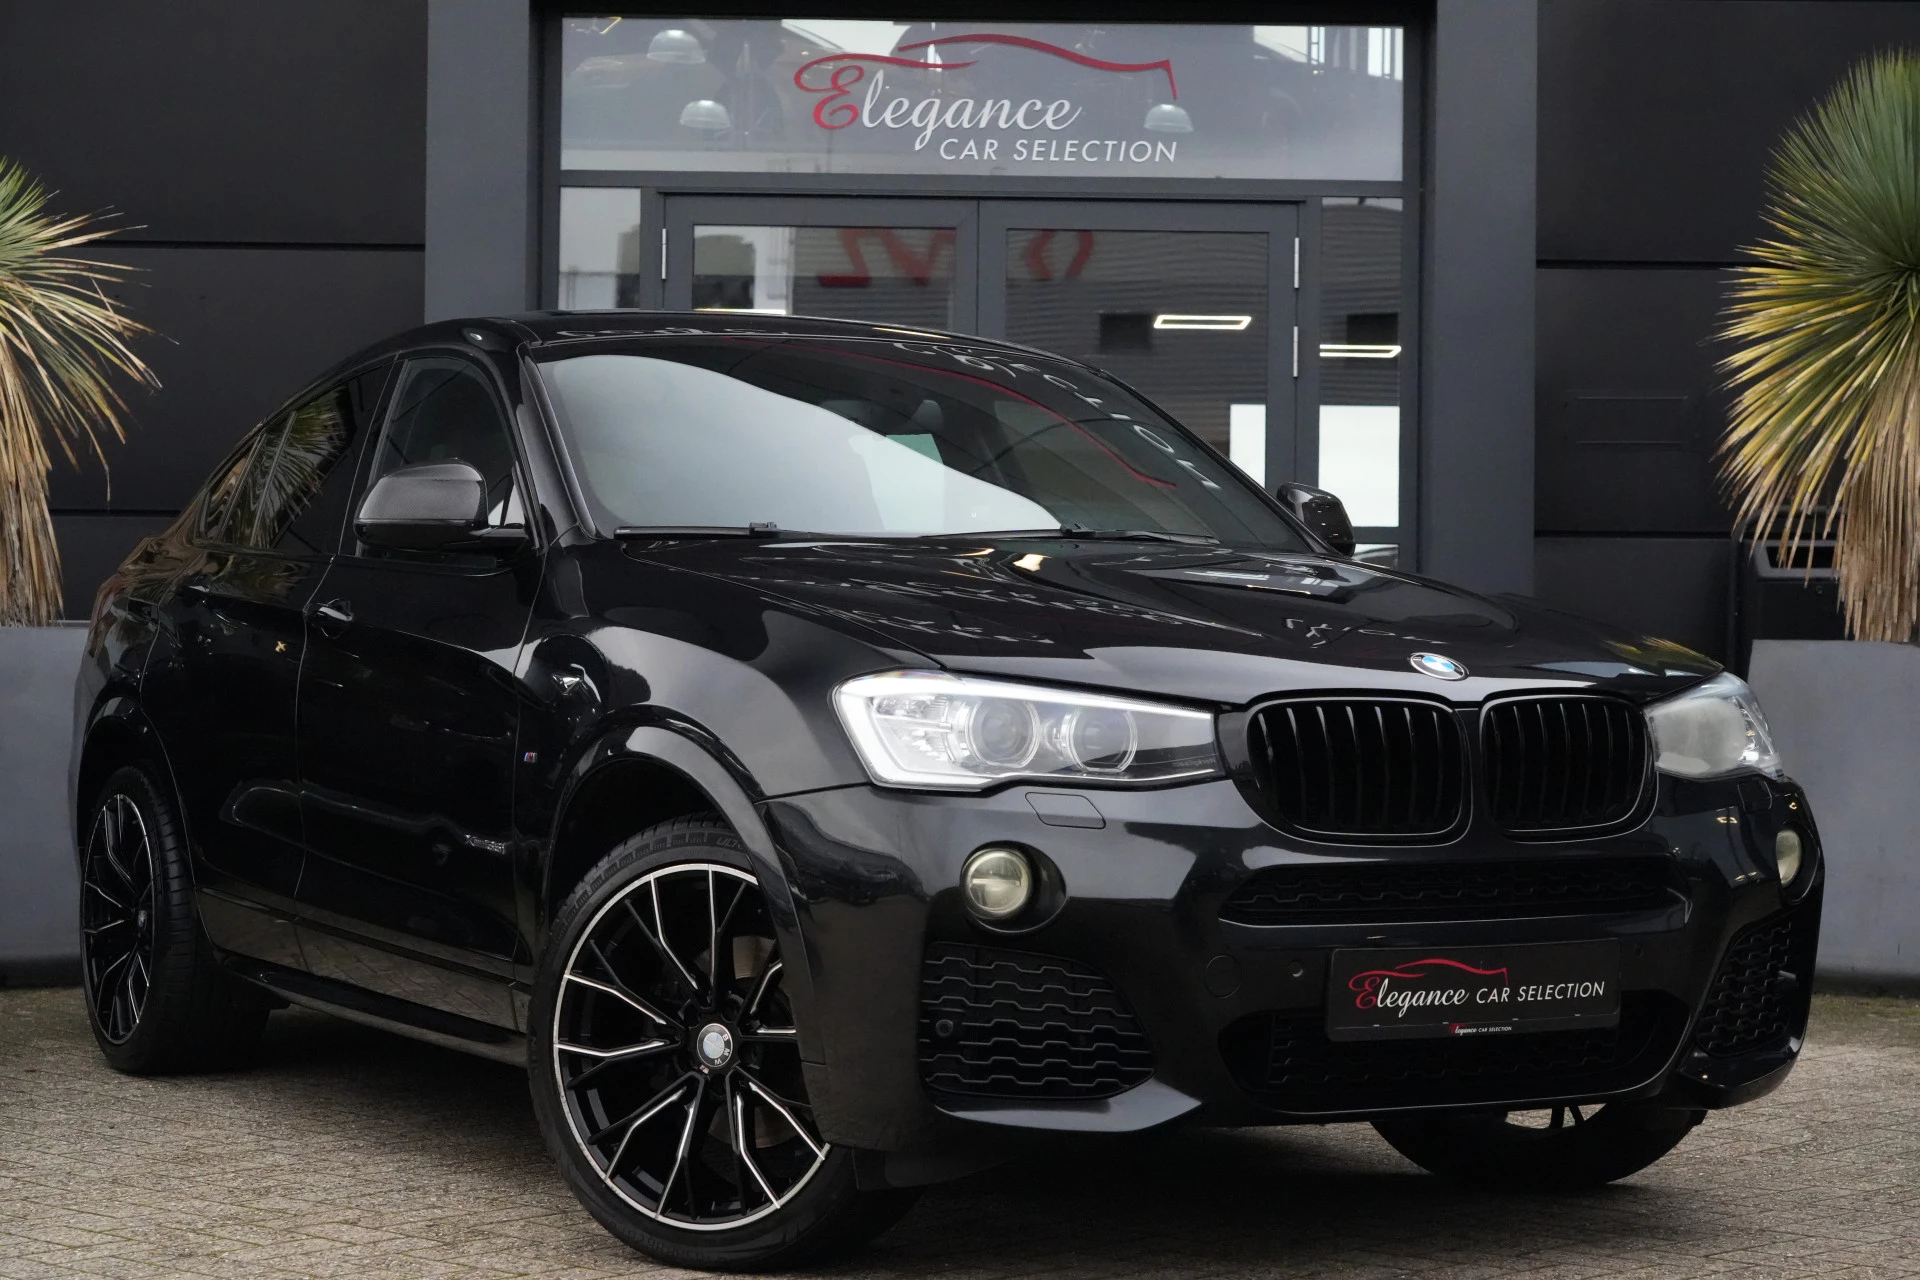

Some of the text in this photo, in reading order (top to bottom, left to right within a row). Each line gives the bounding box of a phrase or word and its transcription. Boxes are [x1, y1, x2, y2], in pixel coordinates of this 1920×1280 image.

[794, 53, 1083, 151] Elegance
[939, 138, 1178, 162] CAR SELECTION
[1348, 970, 1605, 1018] Elegance CAR SELECTION
